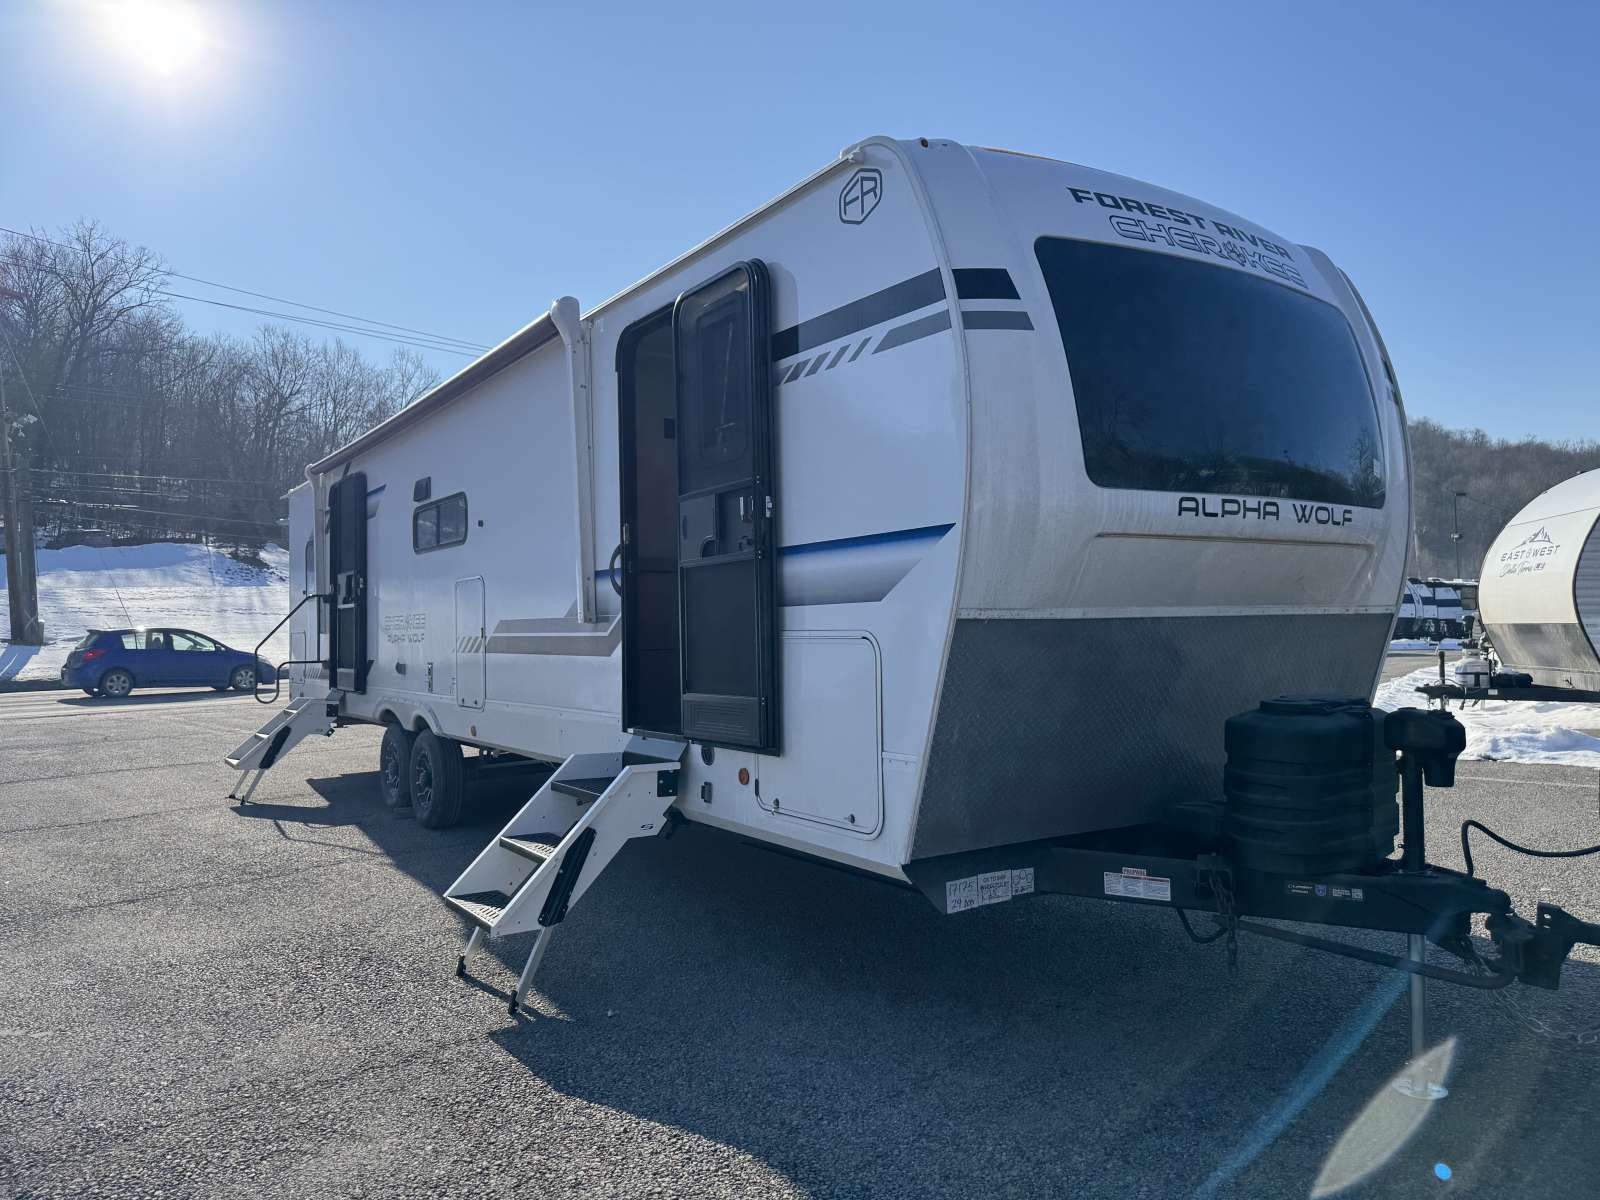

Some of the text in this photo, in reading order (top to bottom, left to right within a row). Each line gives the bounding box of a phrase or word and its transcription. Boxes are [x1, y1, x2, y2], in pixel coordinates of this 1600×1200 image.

[1066, 186, 1295, 262] FOREST RIVER
[1109, 214, 1309, 289] CHERKEE
[1178, 496, 1352, 526] ALPHA WOLF
